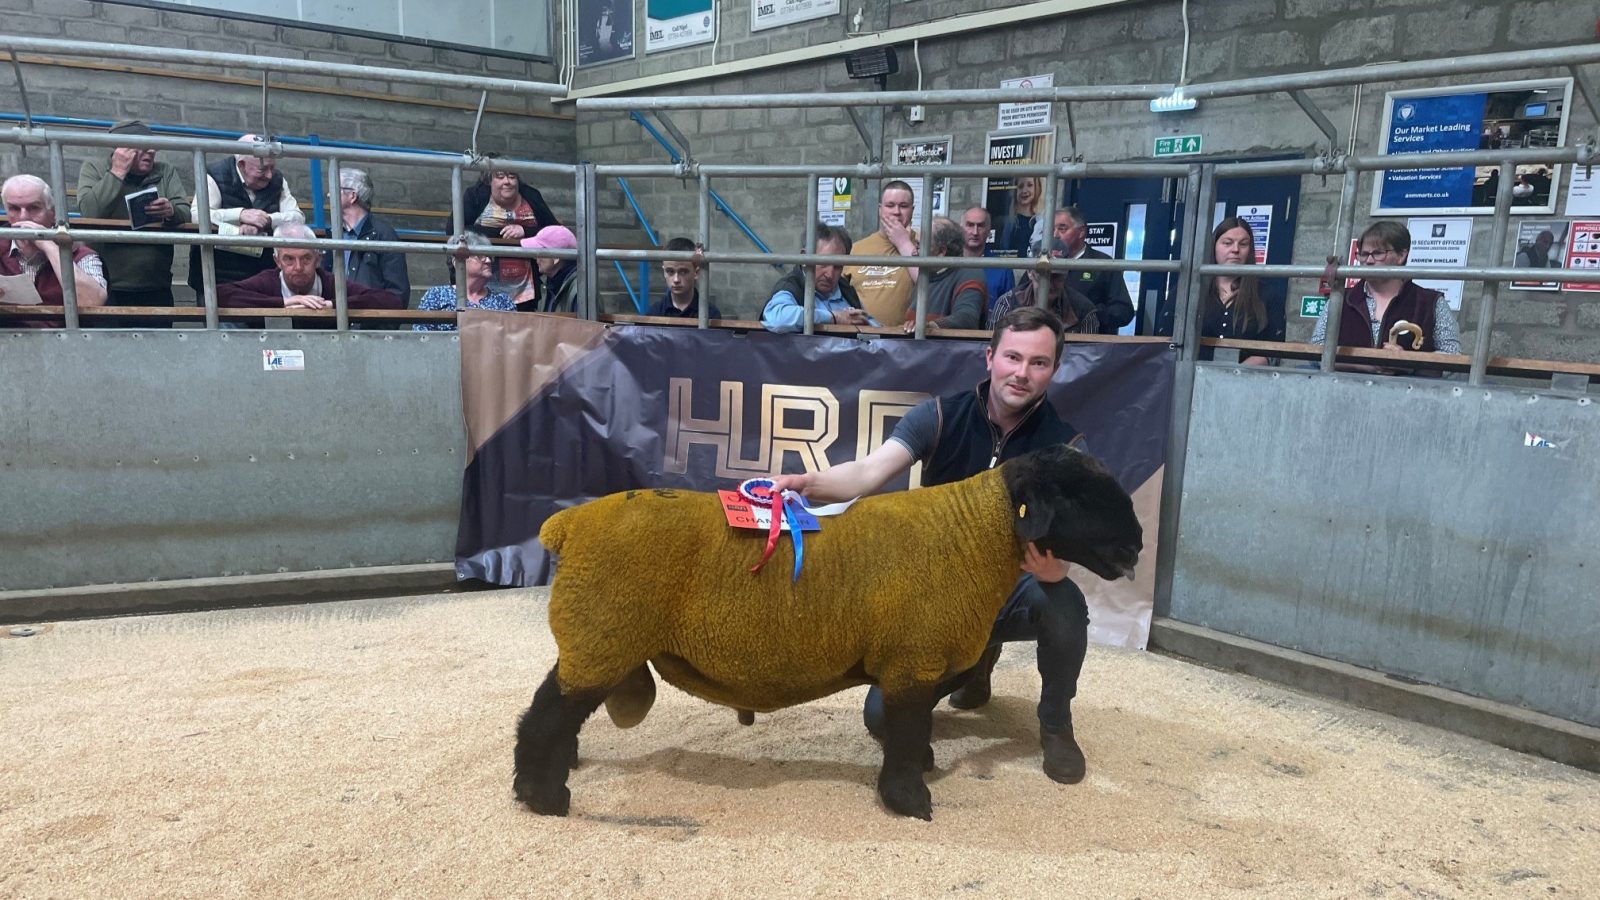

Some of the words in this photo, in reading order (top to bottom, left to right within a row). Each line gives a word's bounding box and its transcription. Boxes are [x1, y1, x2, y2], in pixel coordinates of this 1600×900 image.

[1395, 127, 1409, 135] Our
[1410, 125, 1438, 134] Market
[1440, 123, 1471, 132] Leading
[1394, 135, 1424, 143] Services
[990, 145, 1015, 160] INVEST
[1016, 144, 1024, 158] IN
